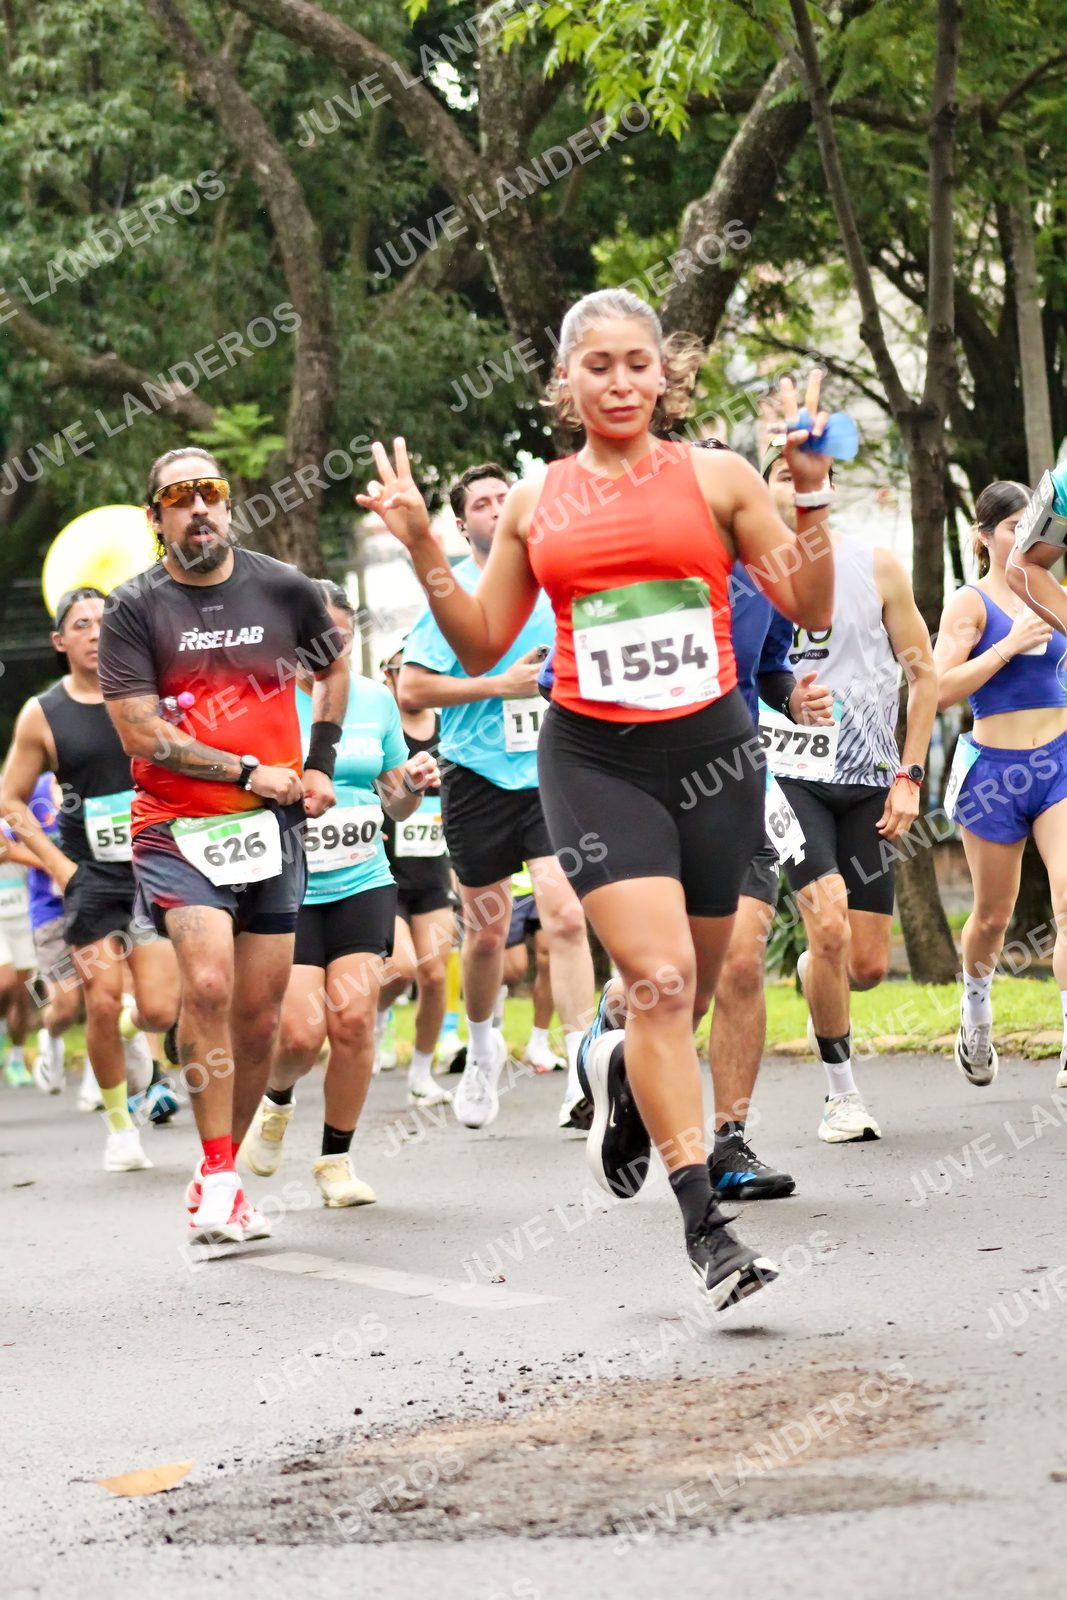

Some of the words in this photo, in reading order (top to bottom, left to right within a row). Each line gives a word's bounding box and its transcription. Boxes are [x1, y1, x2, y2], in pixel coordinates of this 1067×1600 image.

[590, 633, 708, 687] 1554
[512, 711, 539, 733] 11
[759, 724, 830, 758] 5778
[97, 825, 128, 848] 55
[204, 831, 267, 867] 626
